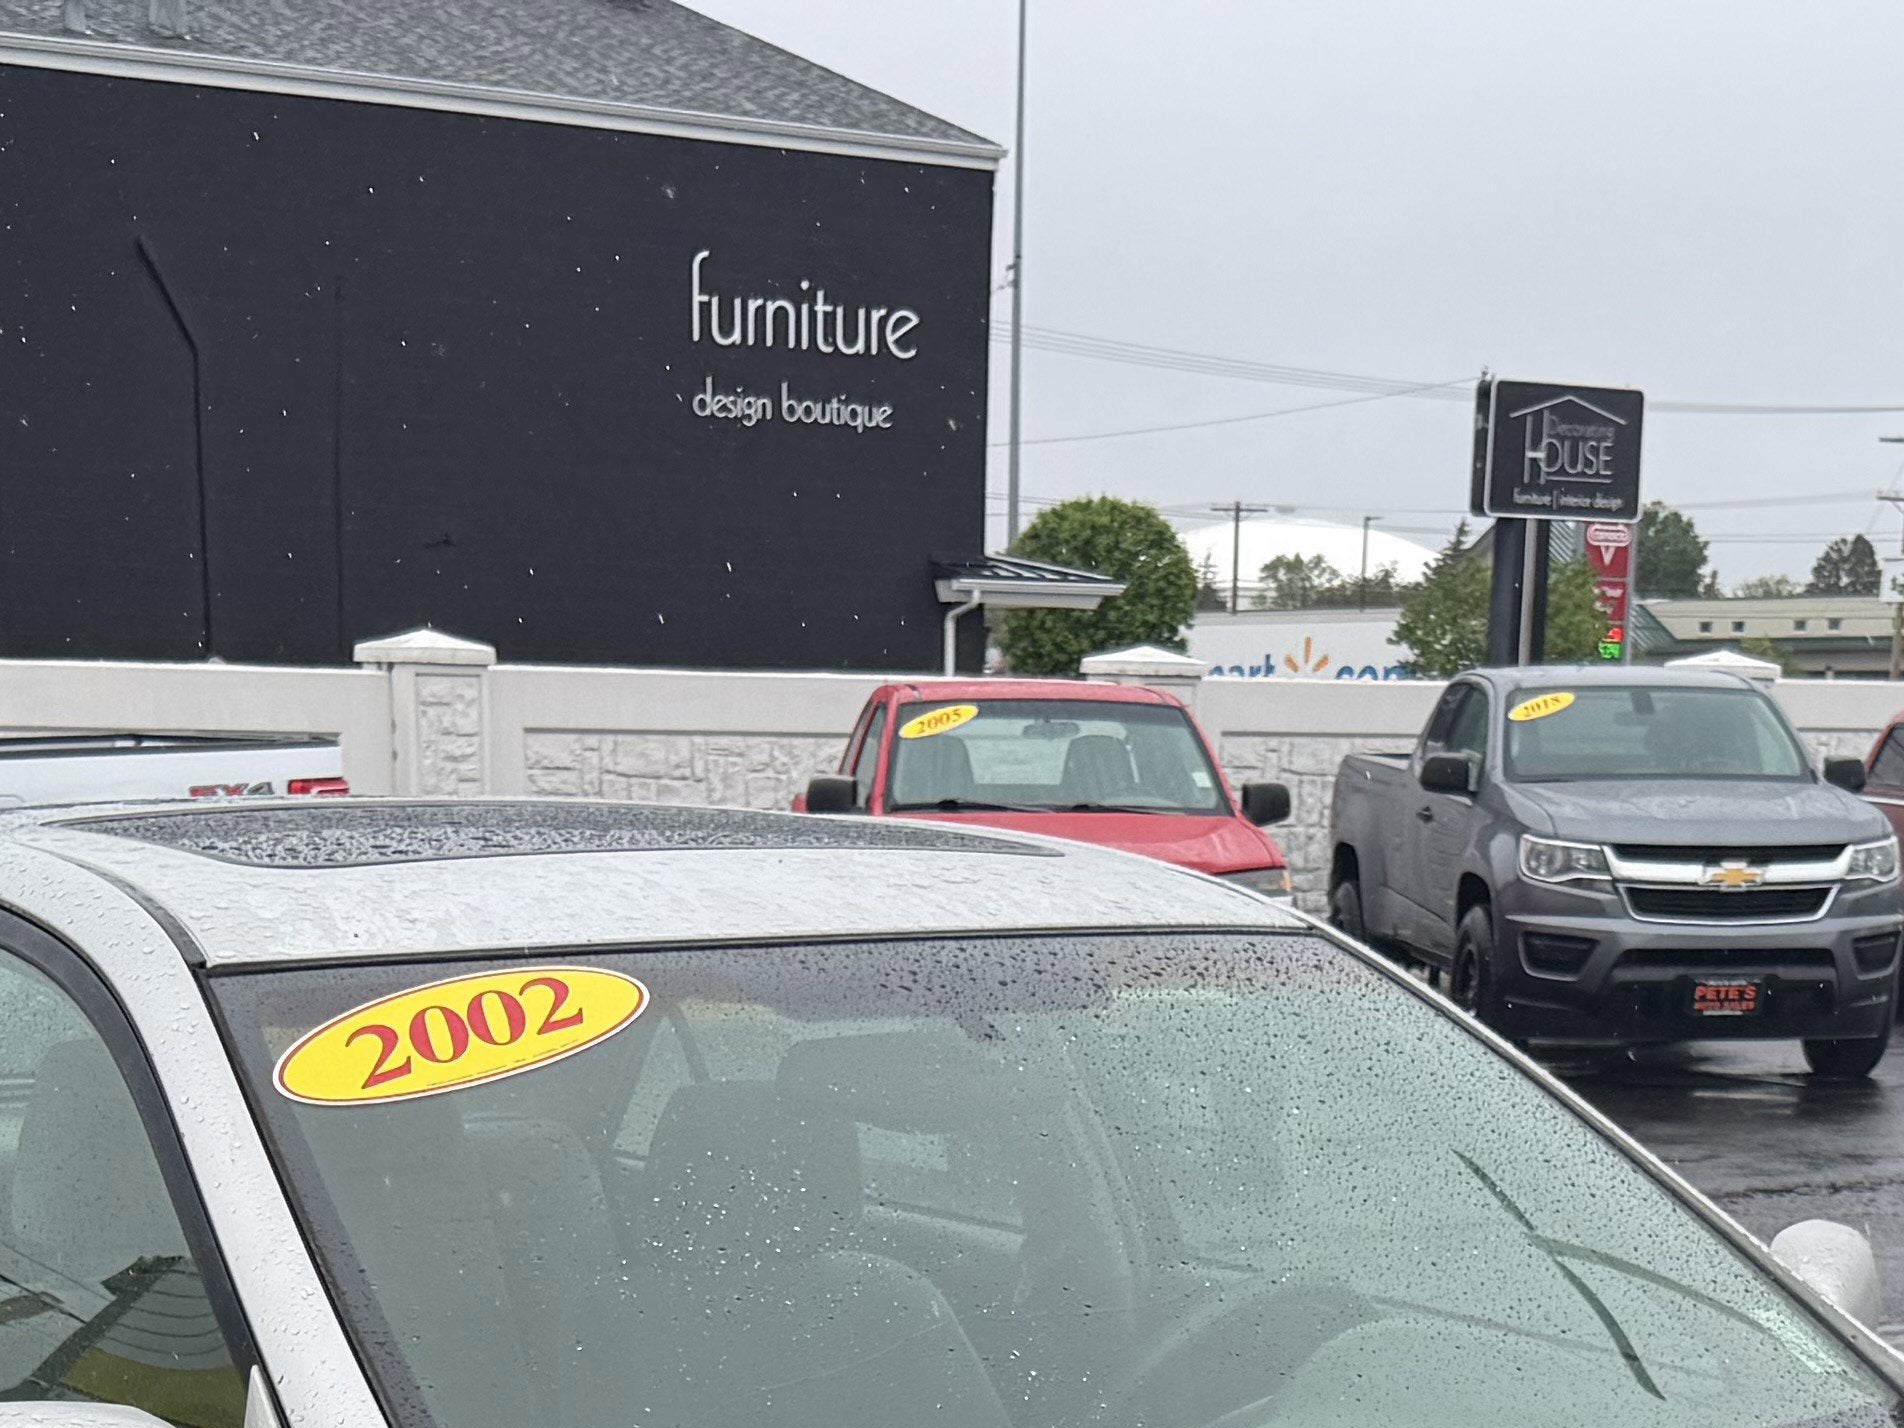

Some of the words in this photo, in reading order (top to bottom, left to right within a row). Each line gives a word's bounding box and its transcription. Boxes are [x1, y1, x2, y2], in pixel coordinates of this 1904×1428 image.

[691, 249, 920, 360] furniture
[692, 375, 773, 427] design
[780, 381, 894, 434] boutique
[1523, 409, 1615, 485] HOUSE
[916, 708, 962, 735] 2005
[1694, 985, 1757, 1001] PETE'S
[344, 976, 585, 1090] 2002
